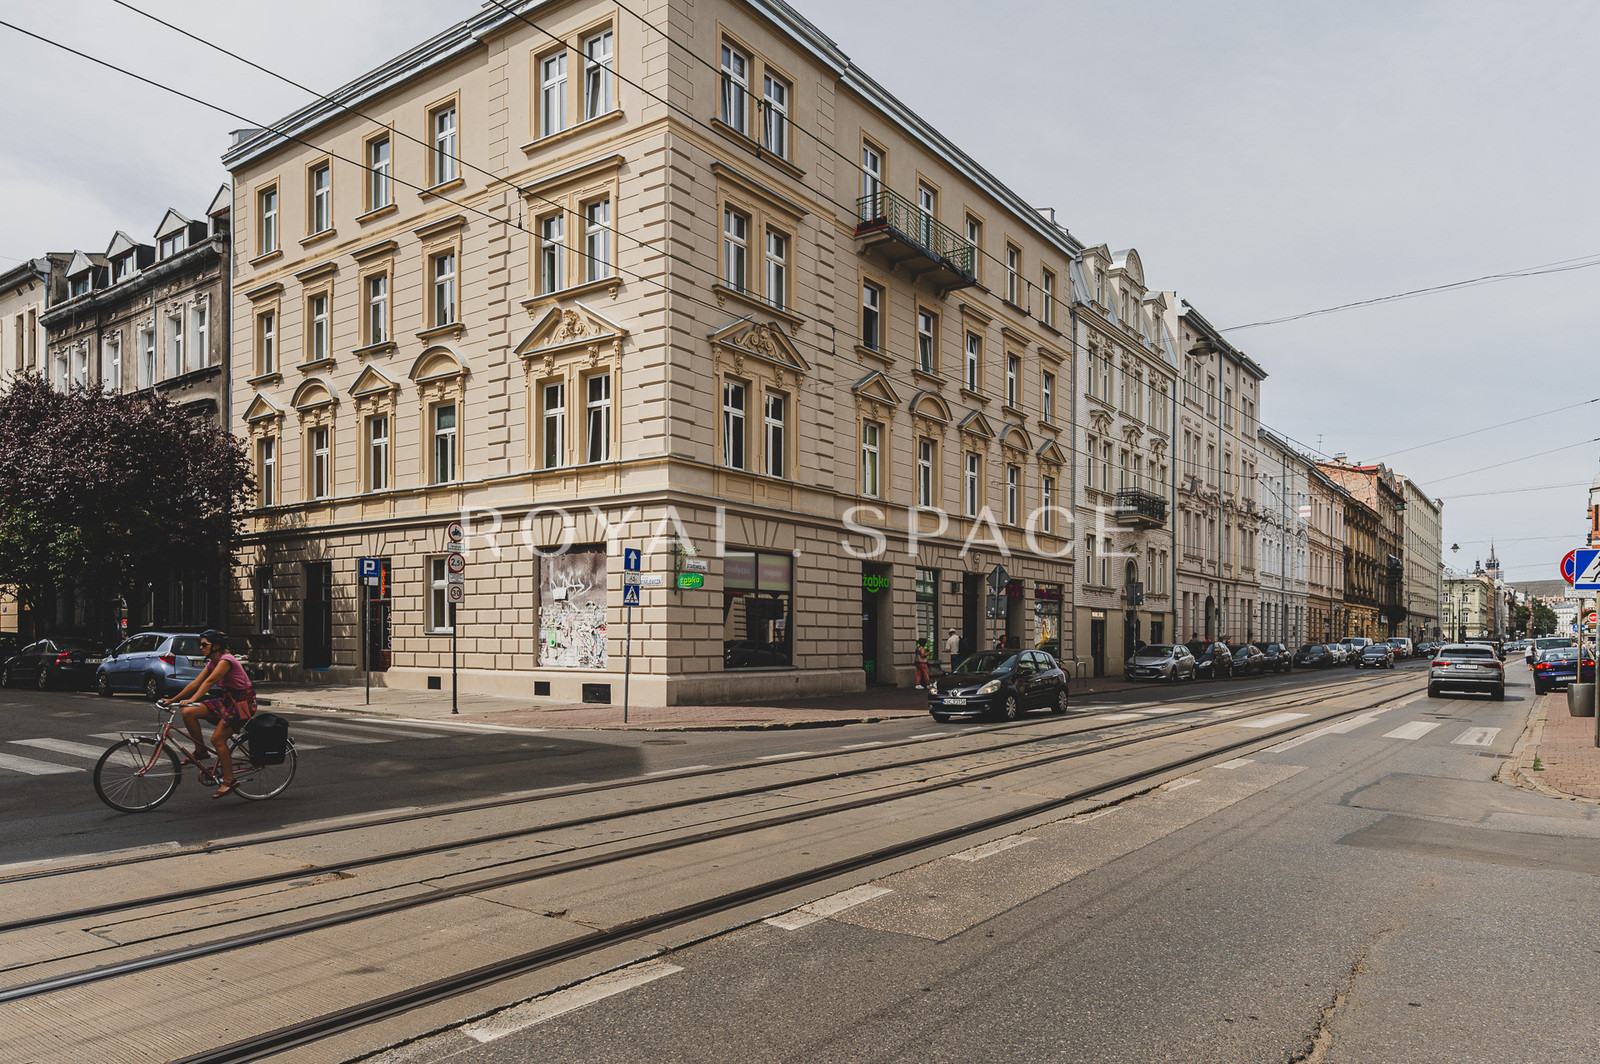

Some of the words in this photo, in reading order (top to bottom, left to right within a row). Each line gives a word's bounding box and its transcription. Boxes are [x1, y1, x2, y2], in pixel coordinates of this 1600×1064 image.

[364, 560, 375, 574] P
[680, 575, 700, 585] żabka
[863, 573, 890, 588] żabka
[452, 589, 461, 597] 30
